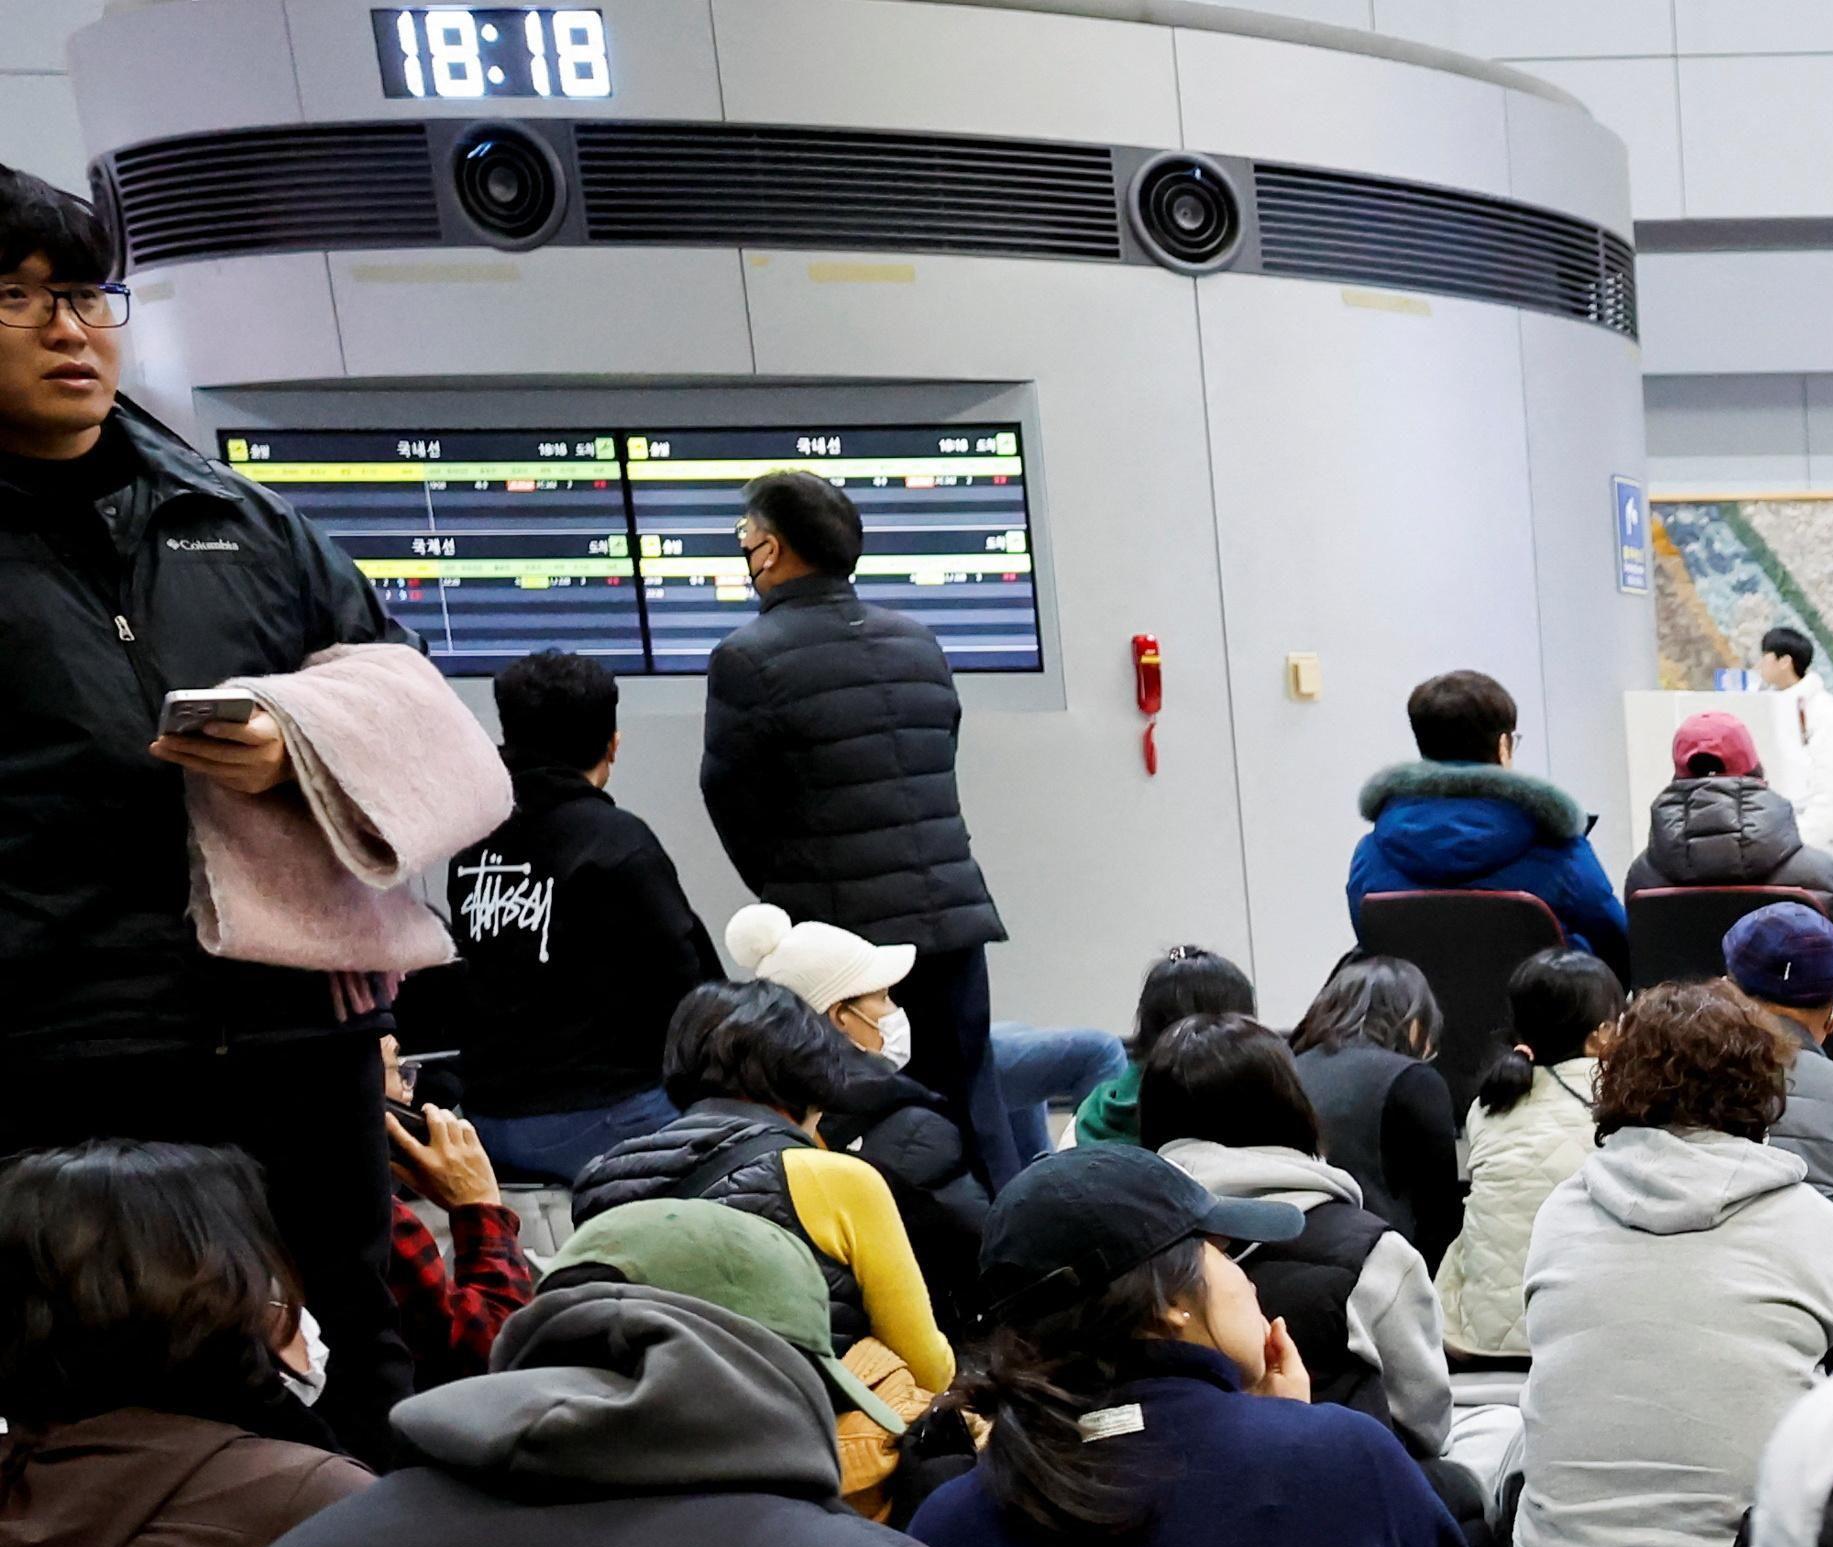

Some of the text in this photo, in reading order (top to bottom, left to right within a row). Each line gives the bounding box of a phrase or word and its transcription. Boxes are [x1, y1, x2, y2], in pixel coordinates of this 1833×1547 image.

[396, 10, 611, 97] 18:18
[397, 440, 441, 459] 국내선
[797, 436, 841, 455] 국내선
[179, 538, 240, 551] Columbia
[411, 537, 456, 556] 국제선
